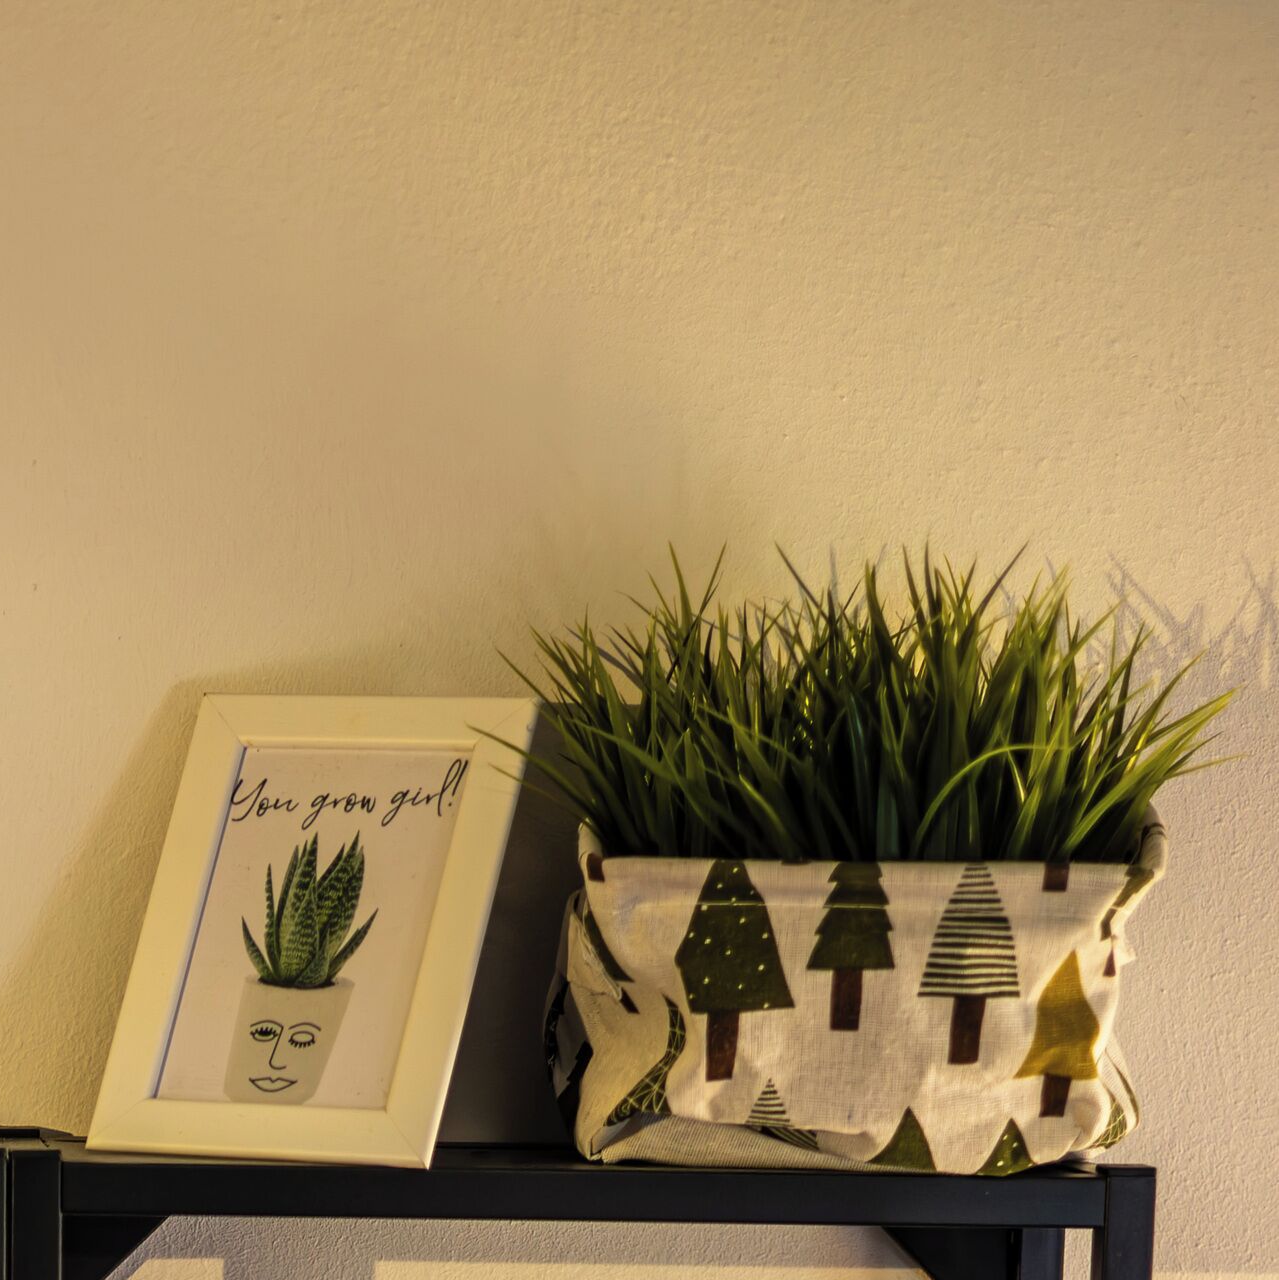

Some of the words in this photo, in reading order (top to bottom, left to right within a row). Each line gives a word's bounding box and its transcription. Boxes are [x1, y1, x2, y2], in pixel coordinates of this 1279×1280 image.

[231, 778, 299, 822] You
[302, 792, 376, 829] grow
[381, 759, 468, 827] girl!
